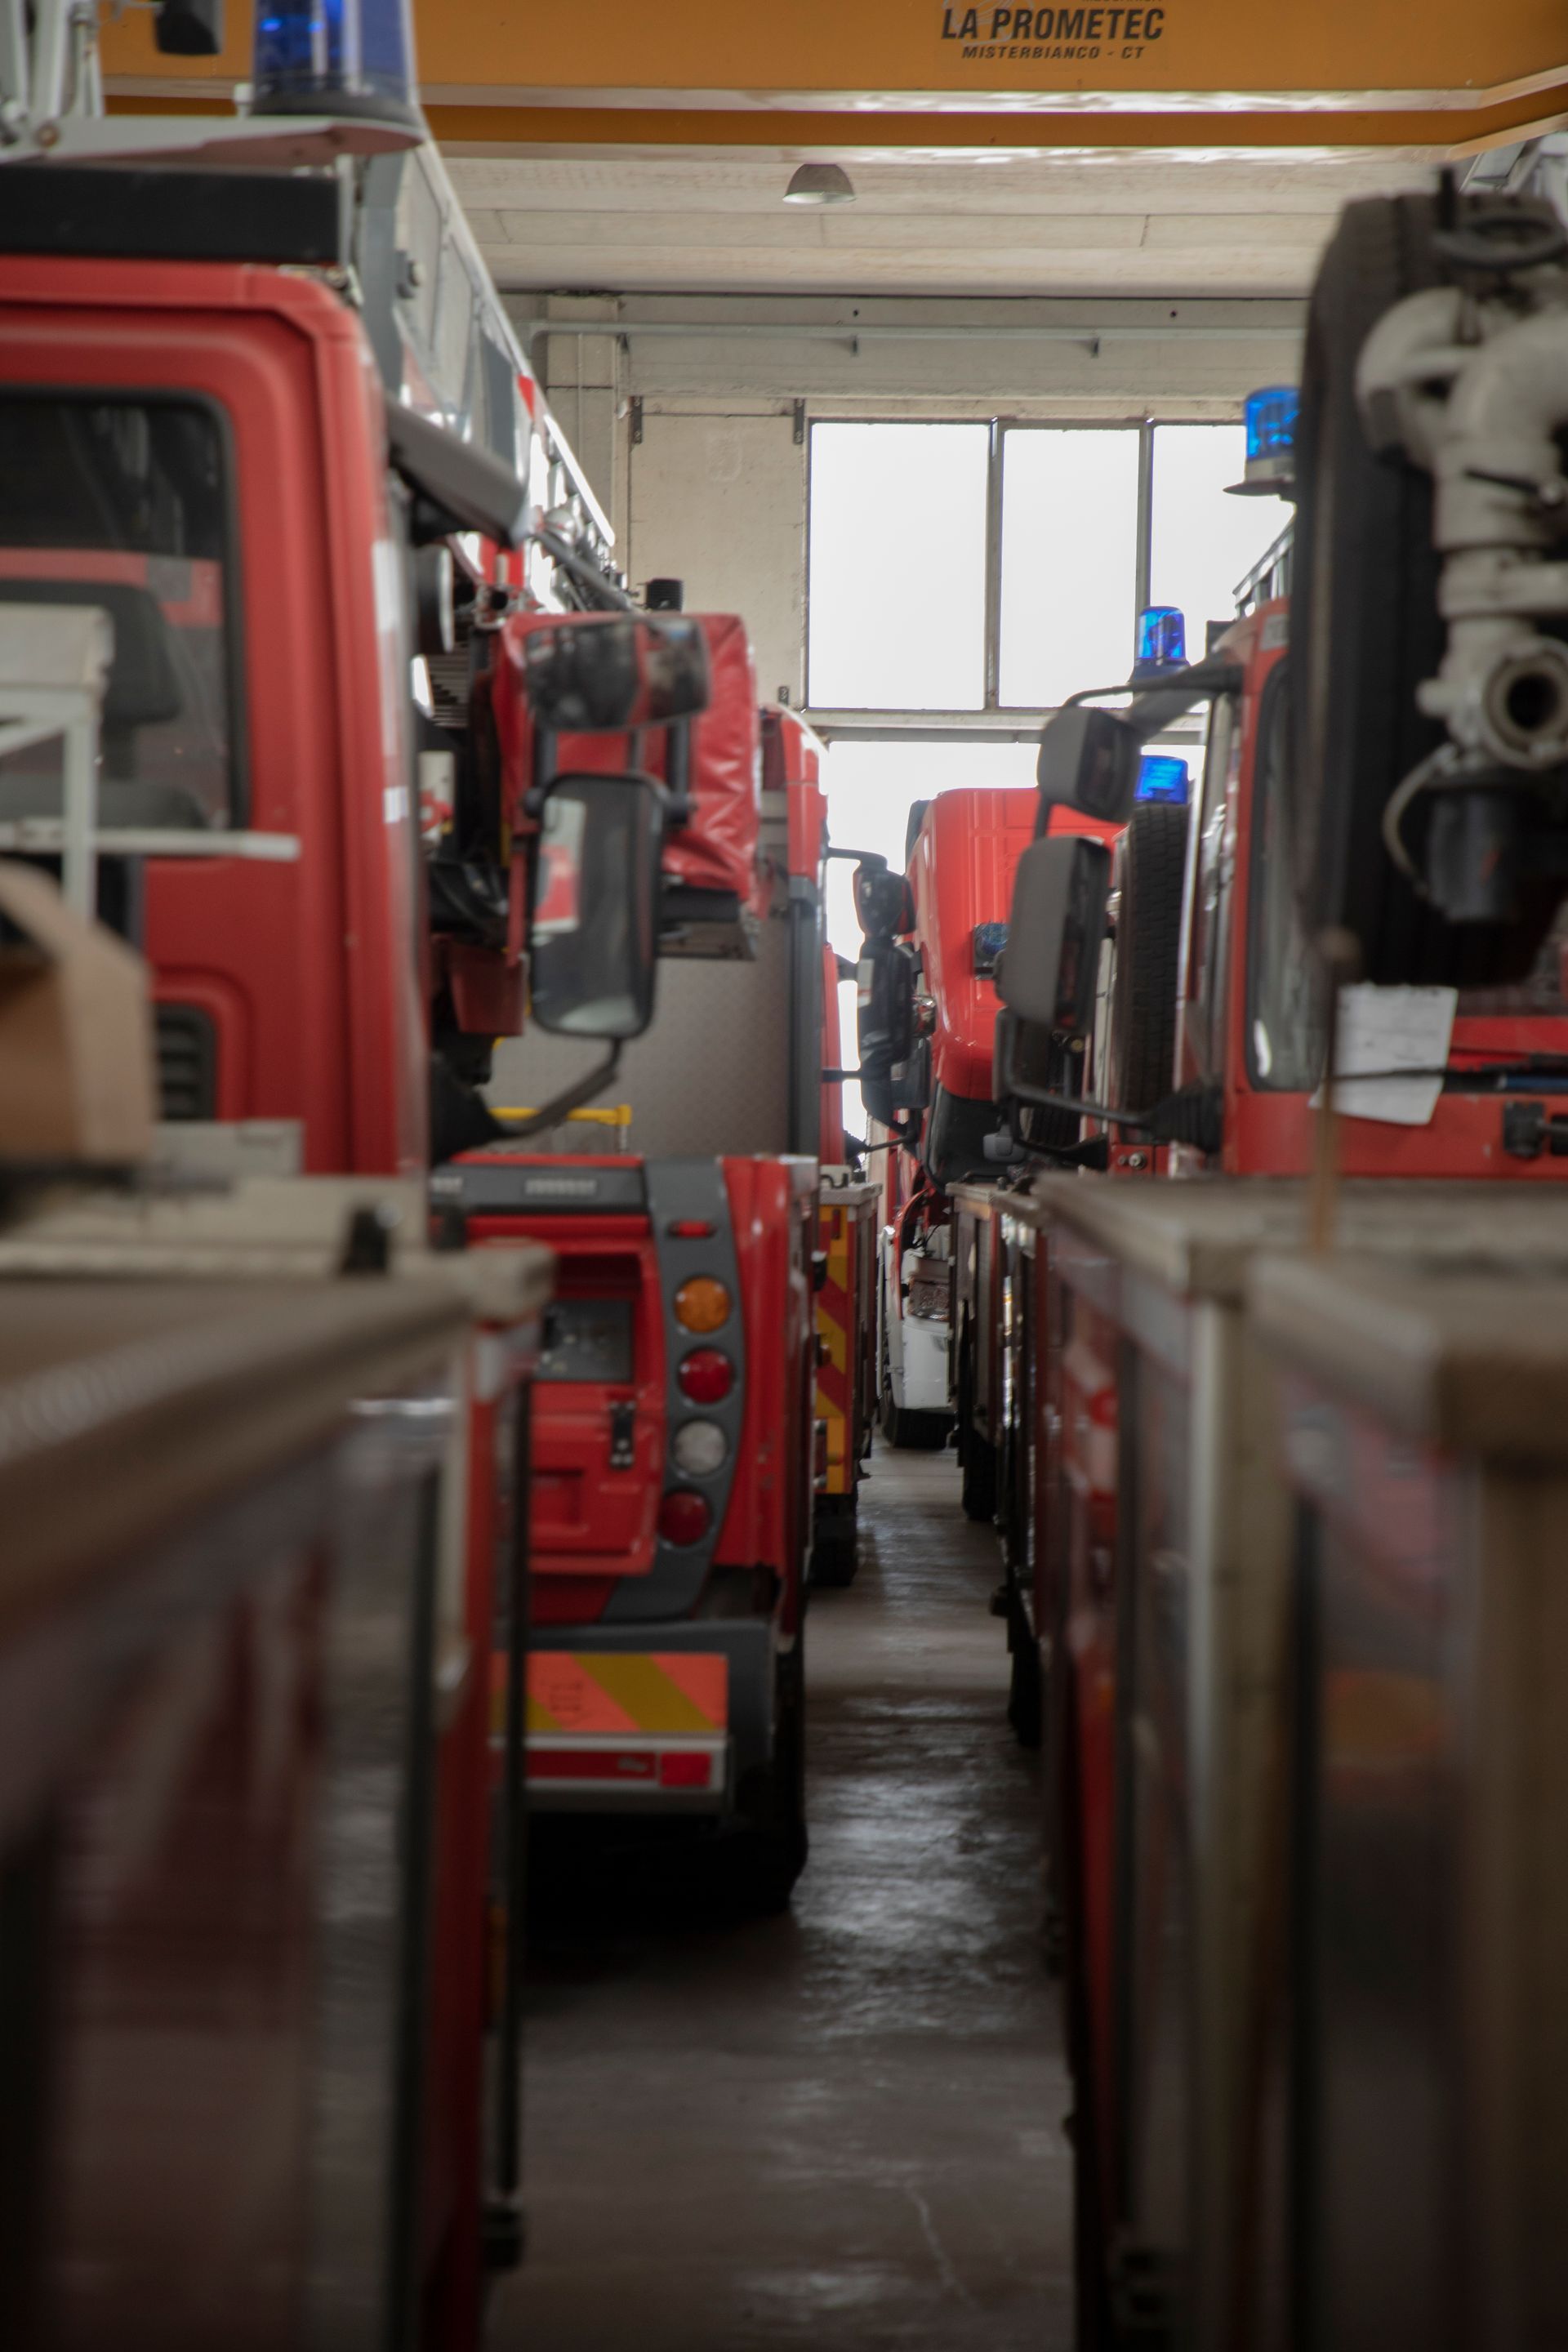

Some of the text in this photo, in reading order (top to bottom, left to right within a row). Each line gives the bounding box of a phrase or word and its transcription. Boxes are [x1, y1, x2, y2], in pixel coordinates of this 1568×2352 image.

[942, 8, 1165, 40] LA PROMETEC
[962, 46, 1099, 60] MISTERBIANCO
[1121, 46, 1145, 60] CT
